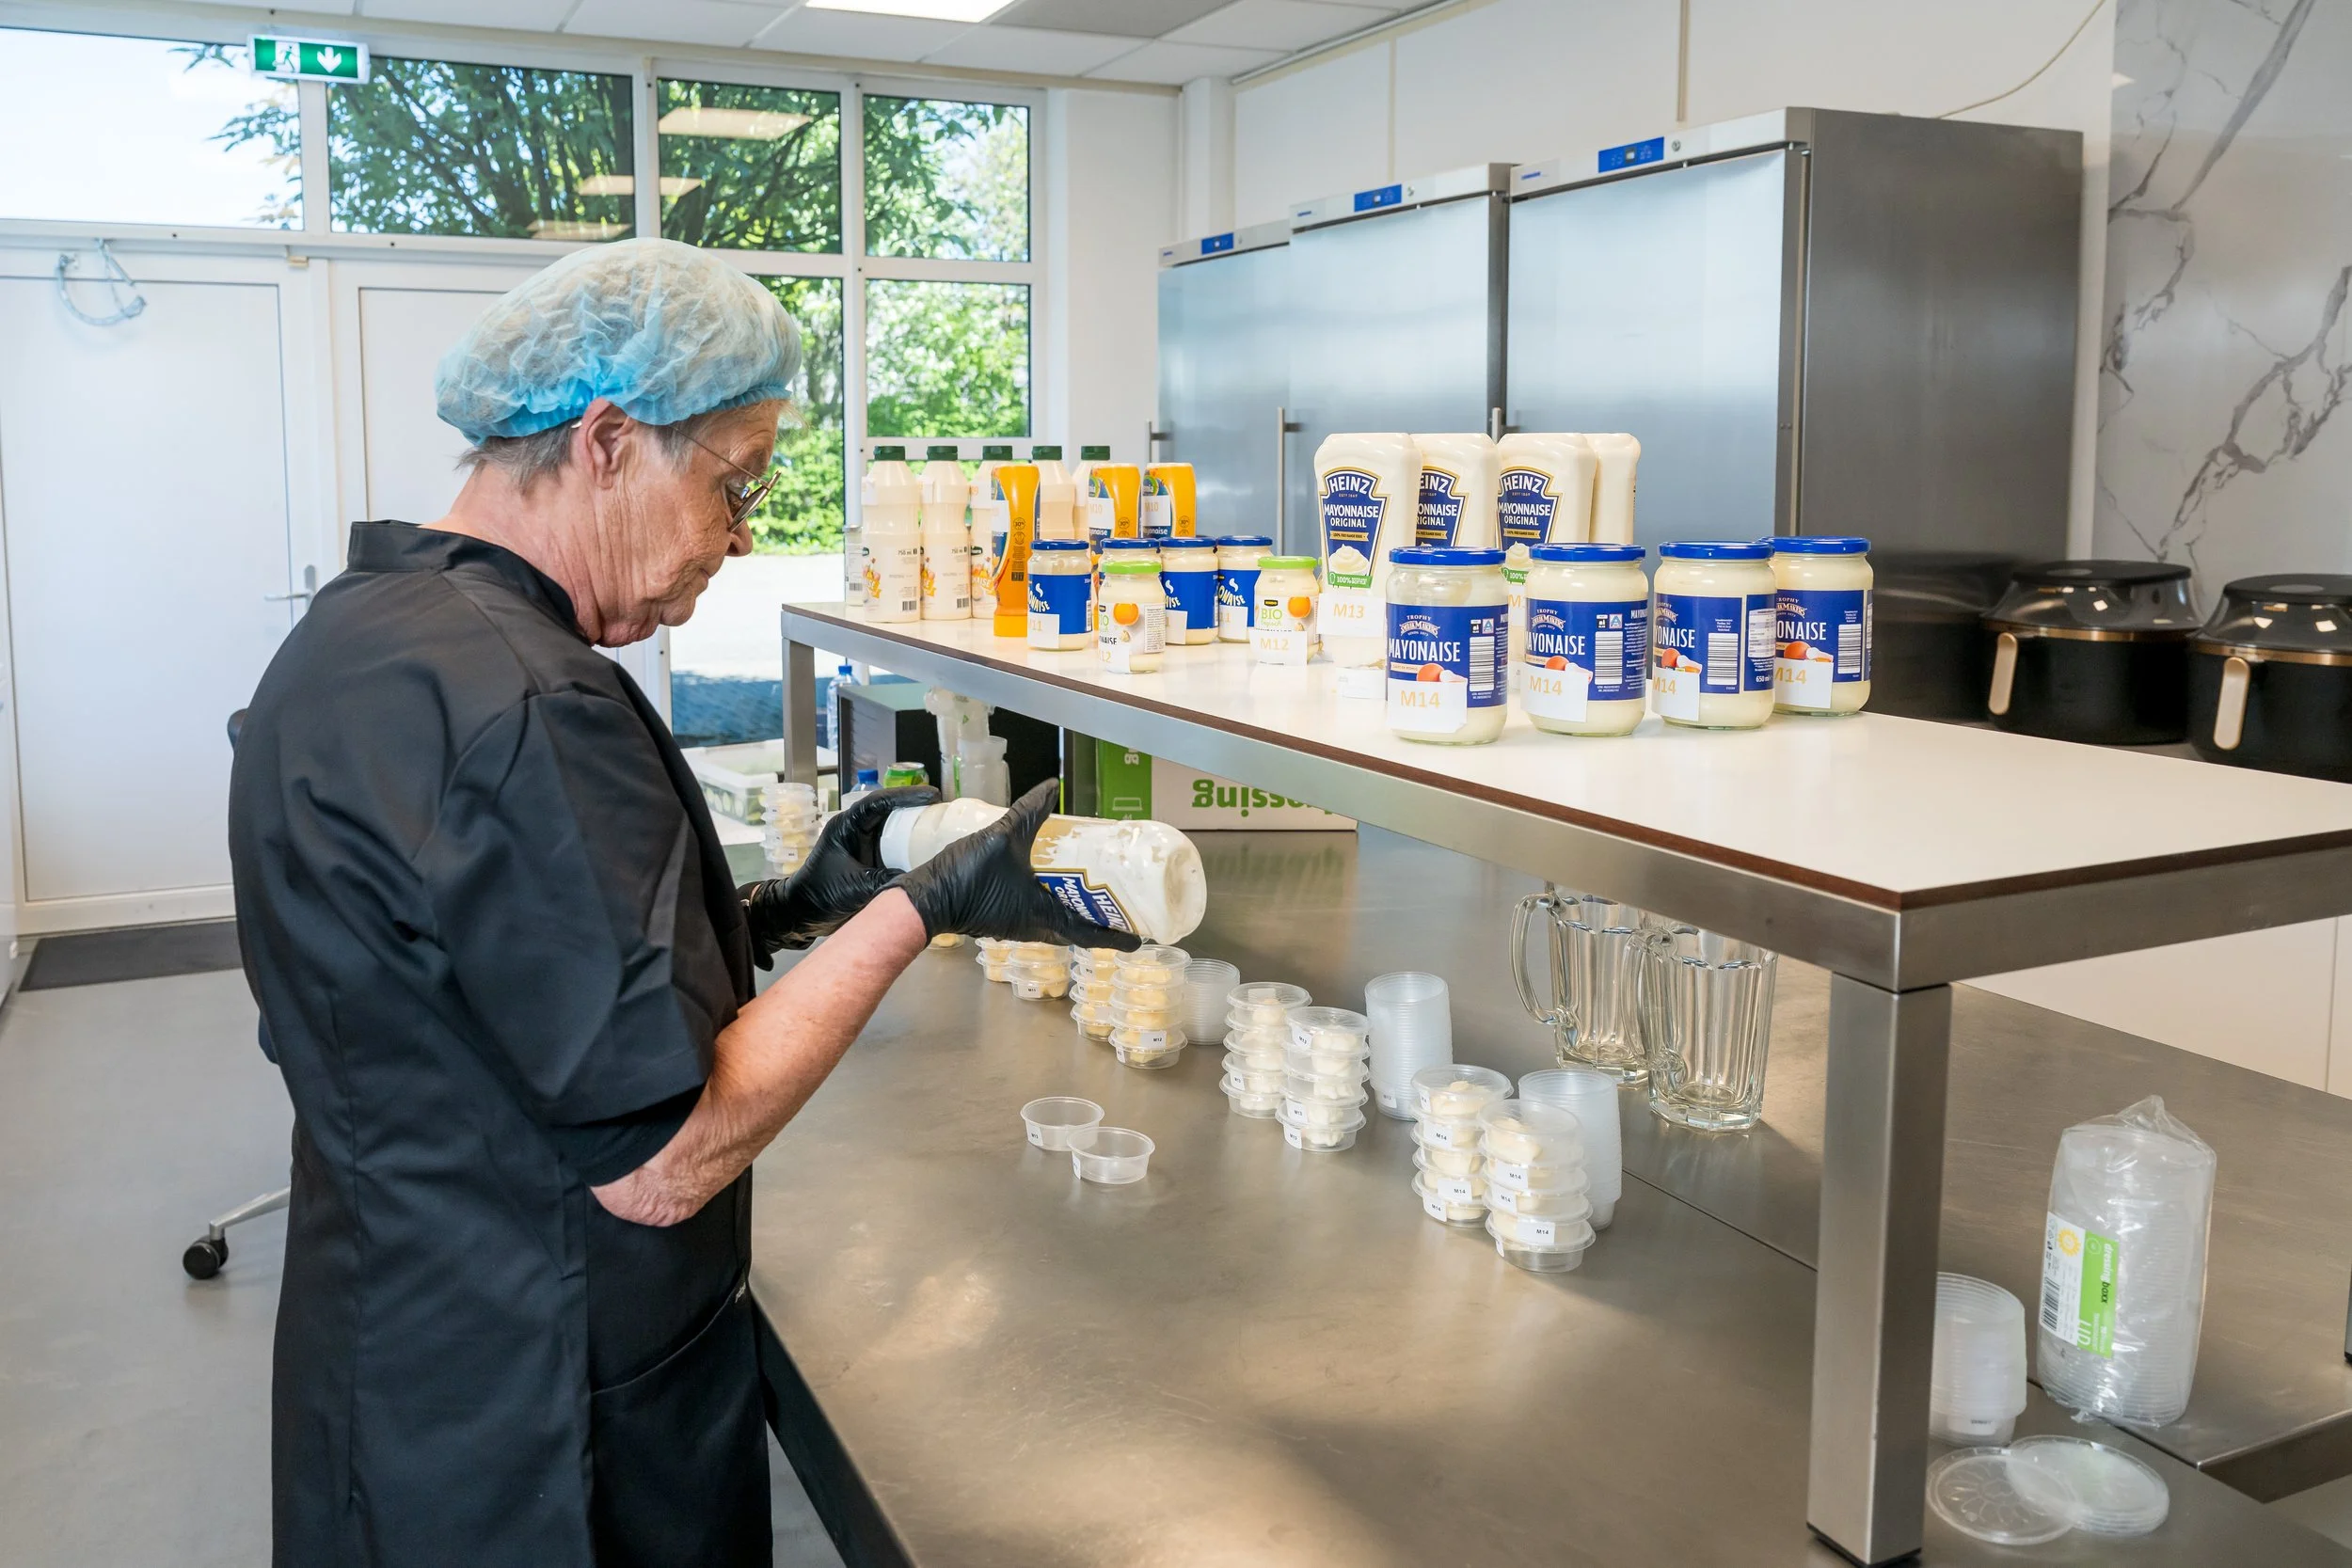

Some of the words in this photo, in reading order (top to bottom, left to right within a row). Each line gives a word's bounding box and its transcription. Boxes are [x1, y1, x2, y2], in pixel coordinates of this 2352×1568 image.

[1329, 476, 1370, 495] HEINZ
[1420, 475, 1449, 494] EINZ
[1503, 475, 1542, 494] HEINZ
[1324, 503, 1379, 518] MAYONNAISE
[1419, 503, 1457, 516] ONNAISE
[1498, 501, 1550, 516] MAYONNAISE
[1330, 517, 1367, 528] ORIGINAL
[1417, 516, 1446, 527] RIGINAL
[1503, 515, 1539, 526] ORIGINAL
[1336, 576, 1352, 584] 100%
[1509, 572, 1524, 580] 100%
[1218, 585, 1246, 607] ONAISE
[1261, 609, 1282, 620] BIO
[1333, 604, 1364, 619] M13
[1776, 621, 1827, 641] ONAISE
[1261, 638, 1289, 651] M12
[1388, 638, 1460, 662] MAYONAISE
[1530, 675, 1562, 695] M14
[1652, 676, 1677, 694] M14
[1401, 690, 1440, 708] M14
[1436, 1132, 1447, 1141] M14
[1501, 1195, 1511, 1203] M14
[1431, 1203, 1441, 1212] M14
[2077, 1319, 2092, 1346] LID
